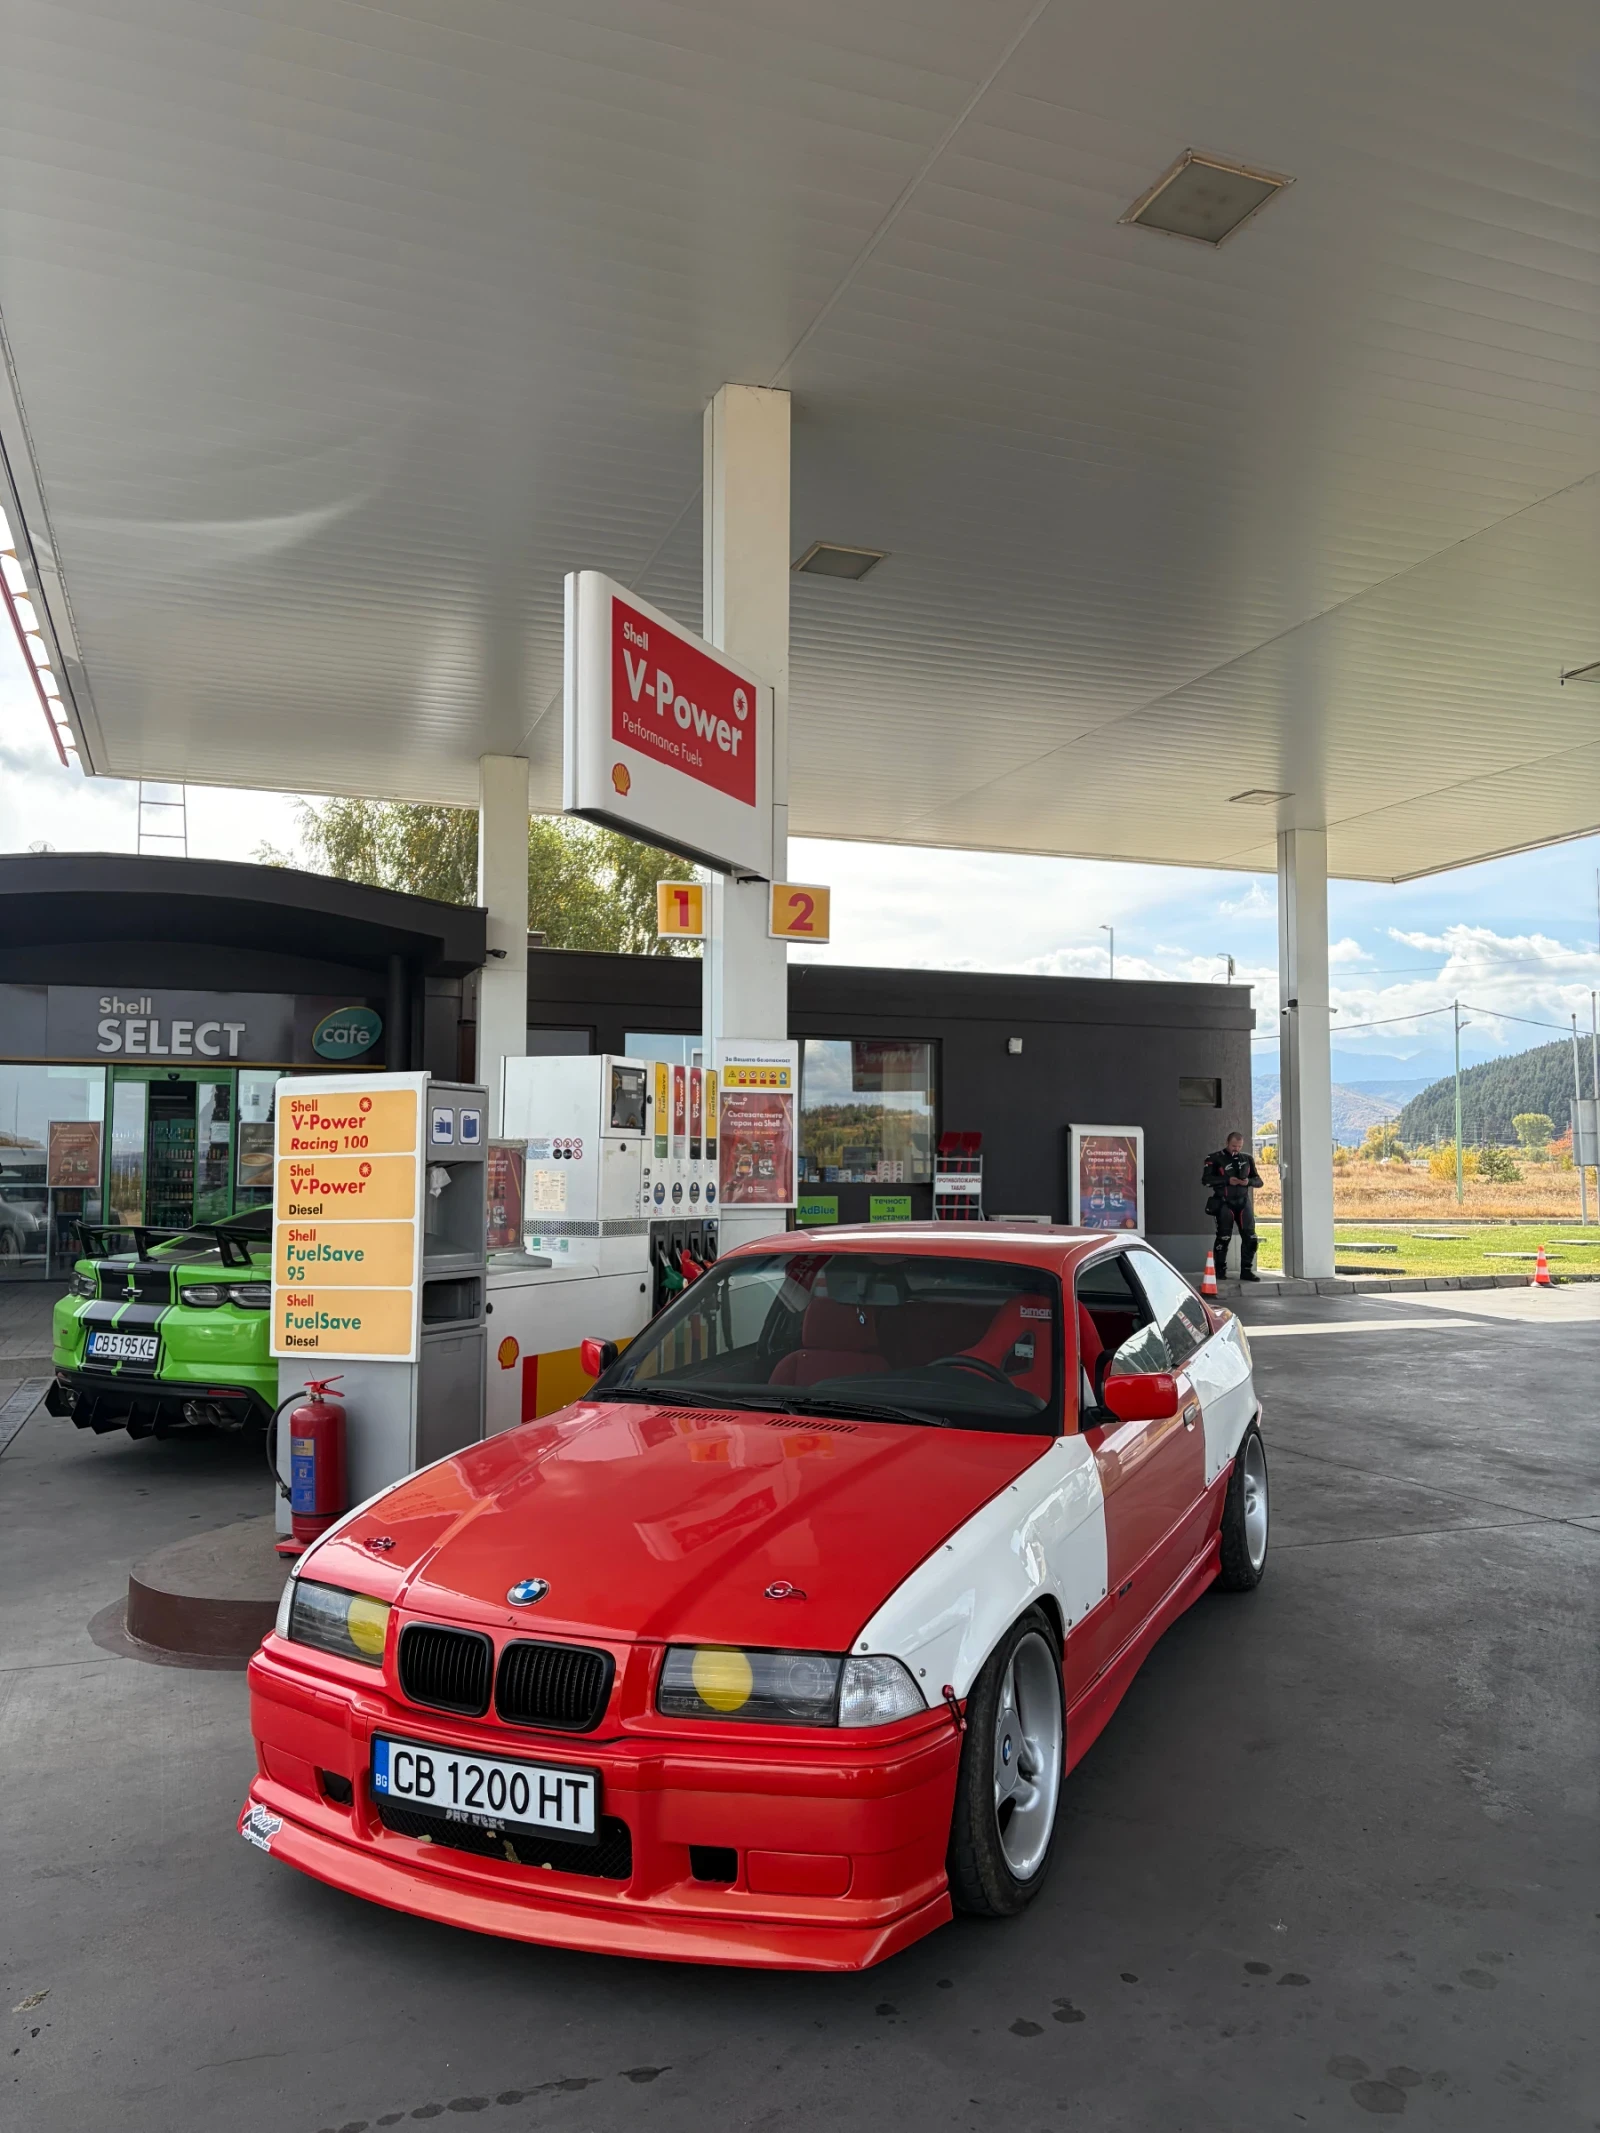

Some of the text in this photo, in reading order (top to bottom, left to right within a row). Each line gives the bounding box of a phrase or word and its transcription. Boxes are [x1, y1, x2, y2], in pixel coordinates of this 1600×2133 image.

[623, 621, 649, 651] Shell
[623, 648, 742, 757] V-Power
[622, 712, 703, 767] Performance Fuels
[673, 890, 690, 927] 1
[787, 893, 814, 931] 2
[99, 996, 152, 1015] Shell
[96, 1019, 246, 1057] SELECT
[322, 1024, 370, 1045] café
[291, 1100, 318, 1112] Shell
[291, 1114, 367, 1131] V-Power
[763, 1119, 780, 1127] Shell
[290, 1137, 338, 1153] Racing
[343, 1135, 369, 1149] 100
[290, 1163, 315, 1177] Shel
[290, 1178, 366, 1195] V-Power
[288, 1203, 323, 1215] Diesel
[800, 1205, 836, 1215] AdBlue
[872, 1213, 910, 1221] чистачки
[288, 1229, 316, 1242] Shell
[287, 1244, 364, 1262] FuelSave
[287, 1266, 305, 1281] 95
[286, 1294, 314, 1307] Shell
[285, 1311, 362, 1330] FuelSave
[285, 1335, 319, 1347] Diesel
[375, 1773, 388, 1788] BG
[394, 1751, 436, 1798] CB
[447, 1761, 530, 1815] 1200
[539, 1775, 588, 1824] HT
